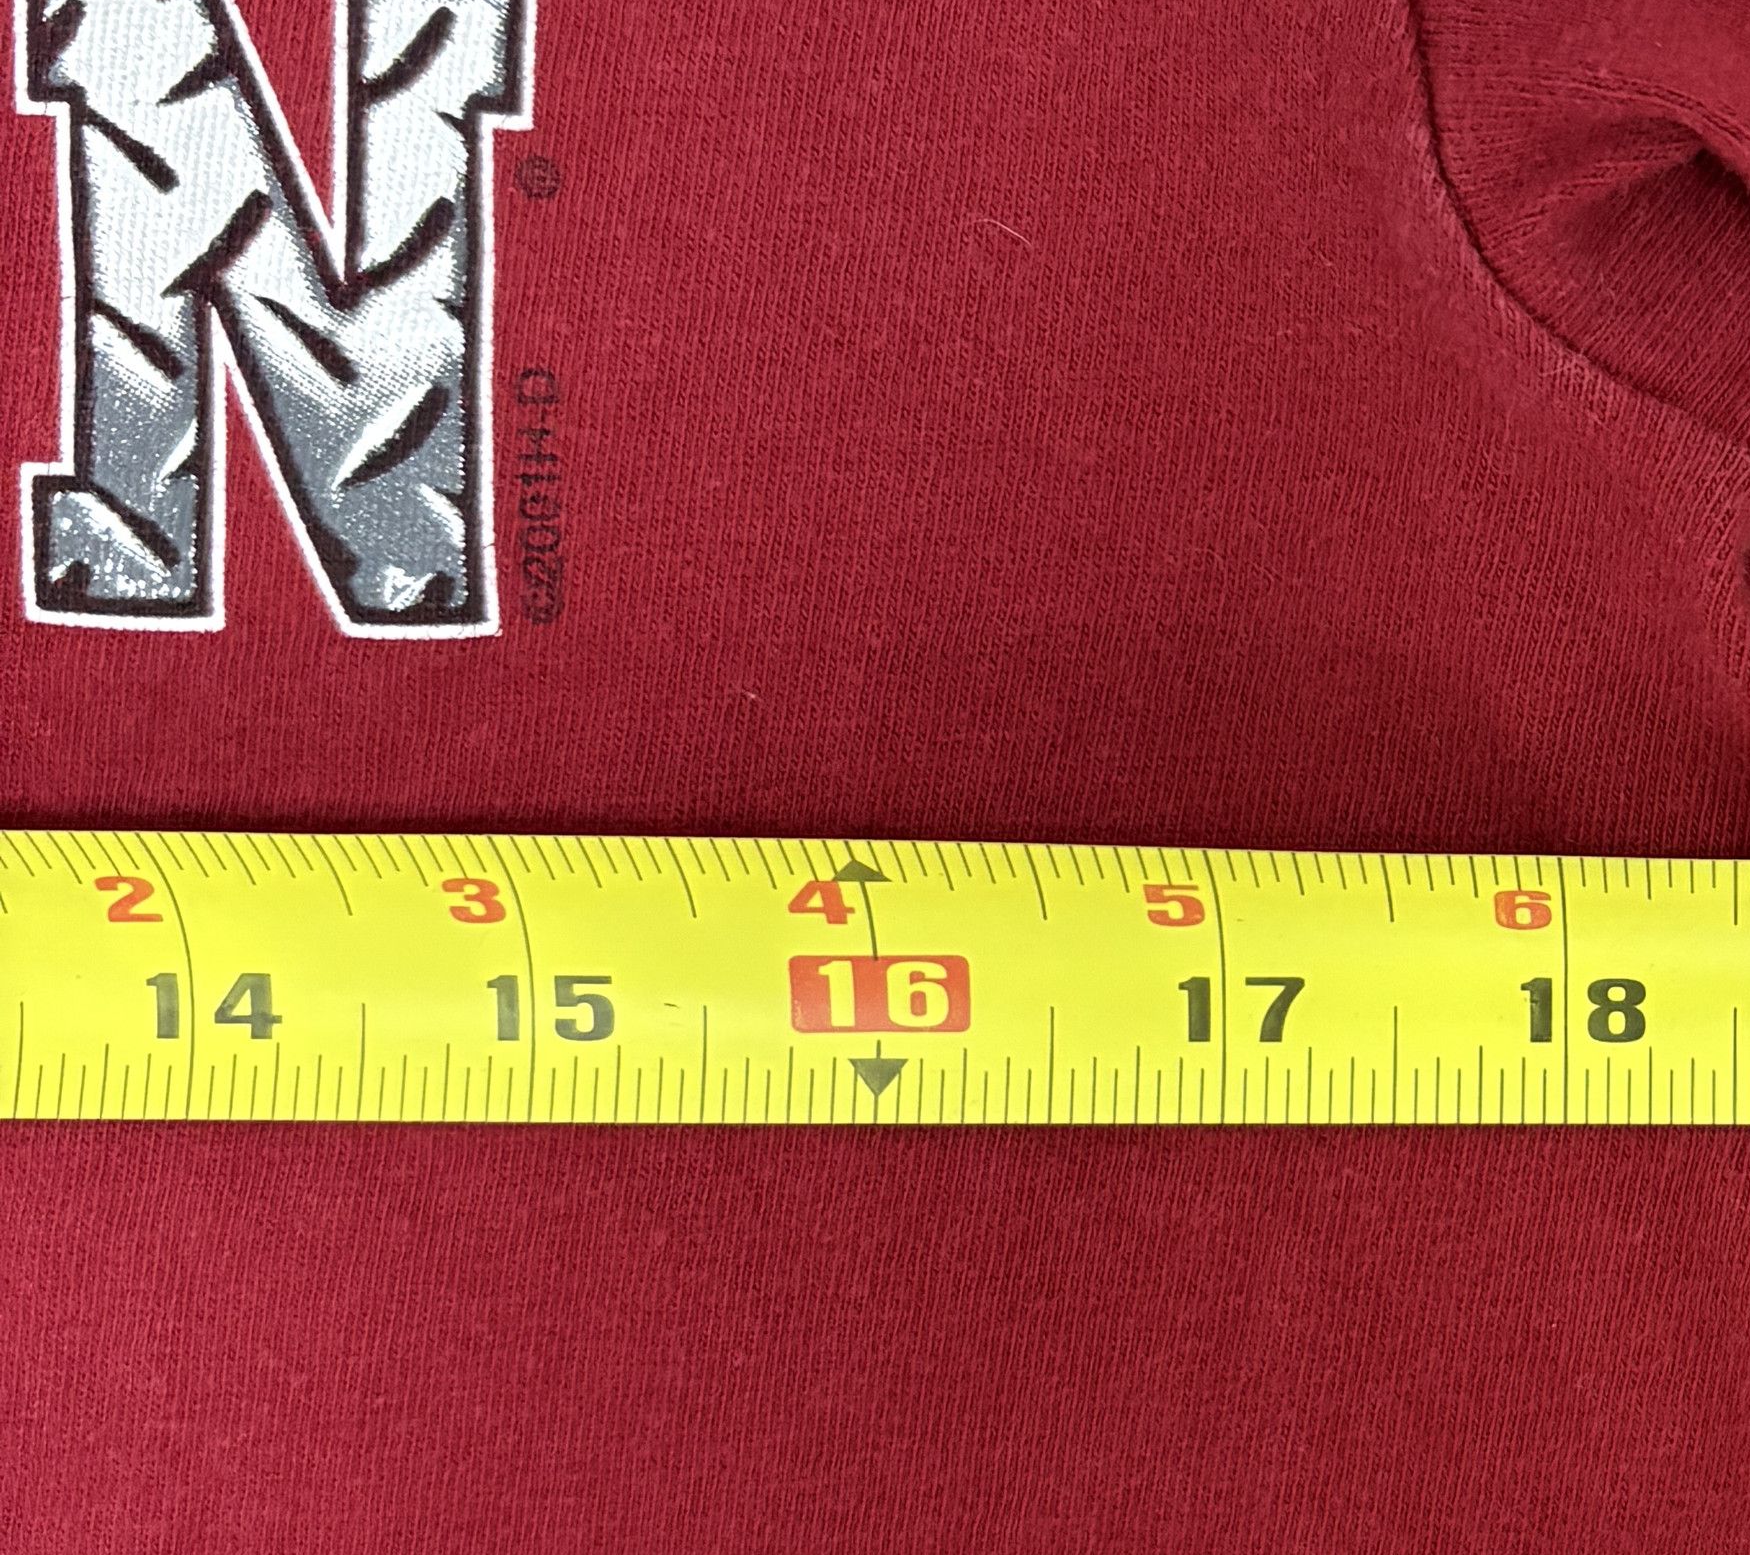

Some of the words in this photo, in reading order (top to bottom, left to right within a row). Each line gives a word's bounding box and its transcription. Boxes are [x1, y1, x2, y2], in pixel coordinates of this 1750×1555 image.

[95, 876, 163, 923] 2
[441, 879, 507, 924] 3
[788, 880, 855, 926] 4
[1144, 884, 1206, 926] 5
[1493, 890, 1552, 930] 6
[145, 972, 282, 1040] 14
[486, 974, 616, 1041] 15
[818, 960, 951, 1028] 16
[1178, 976, 1305, 1042] 17
[1521, 977, 1646, 1043] 18
